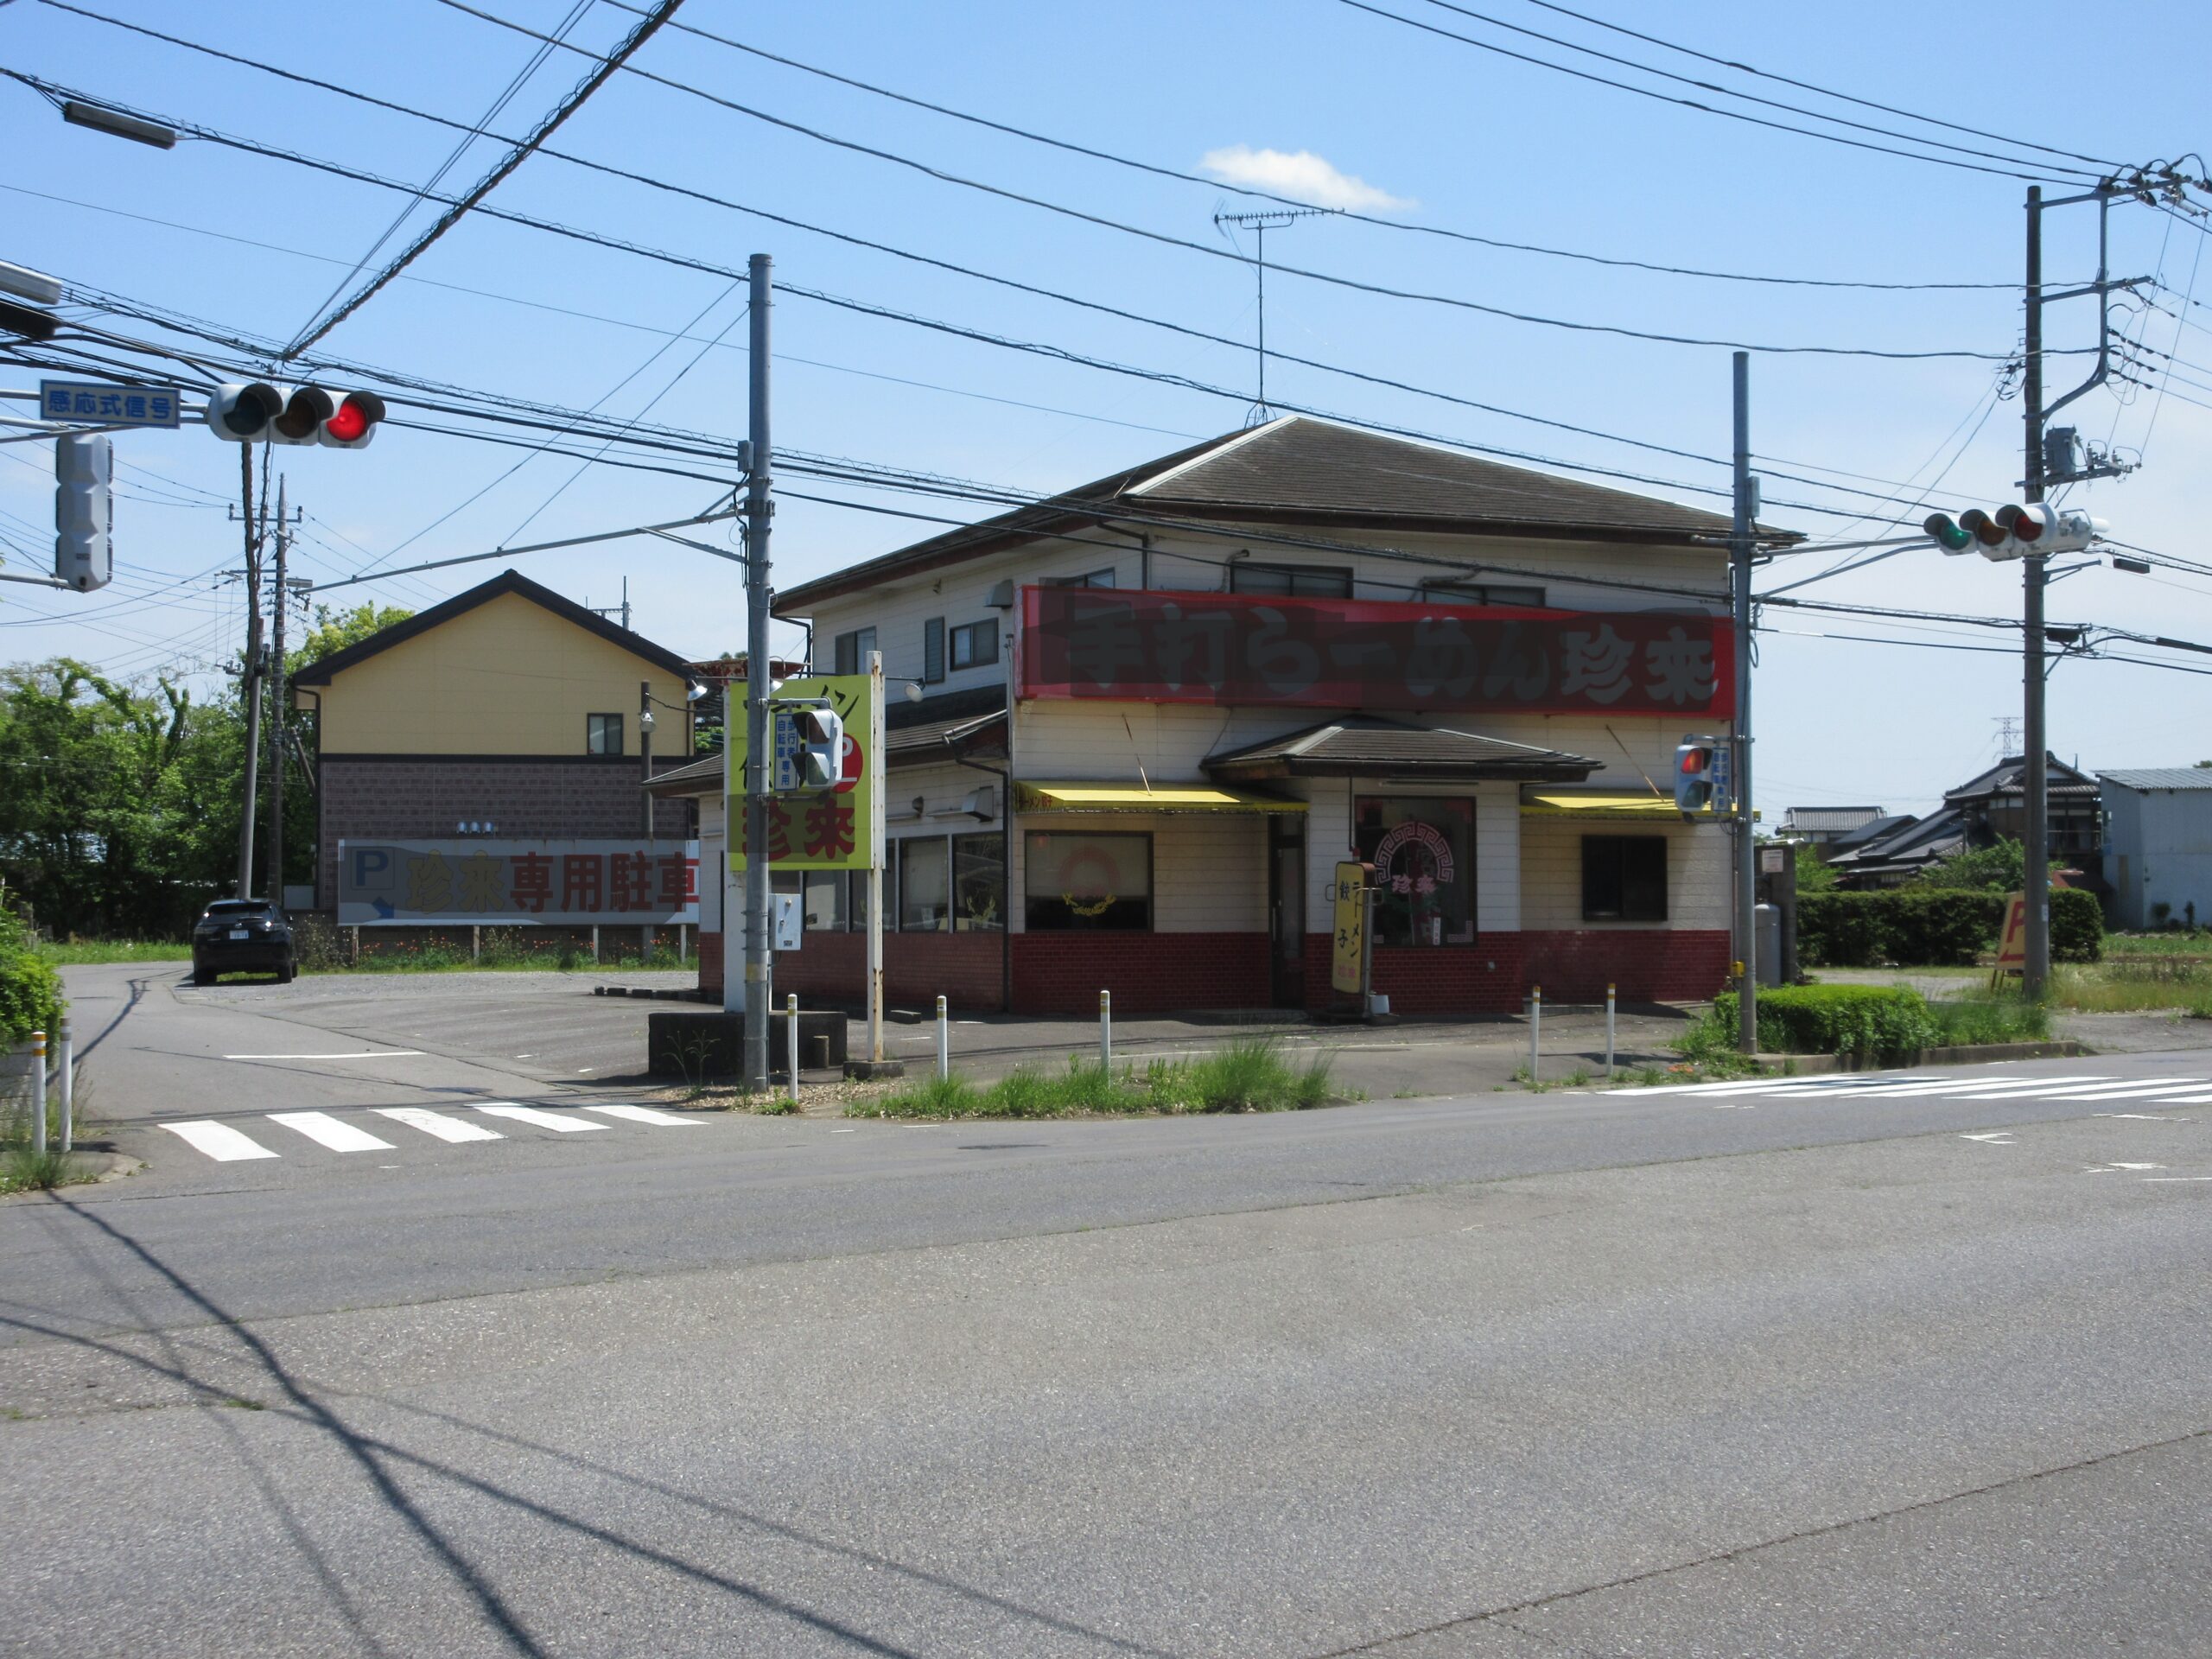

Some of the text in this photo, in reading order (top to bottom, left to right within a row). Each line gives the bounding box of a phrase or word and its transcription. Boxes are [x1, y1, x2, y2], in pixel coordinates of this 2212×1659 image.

[48, 390, 171, 420] 感応式信号
[356, 850, 389, 887] P
[1338, 880, 1350, 948] 餃子
[1350, 881, 1361, 957] ラーメン
